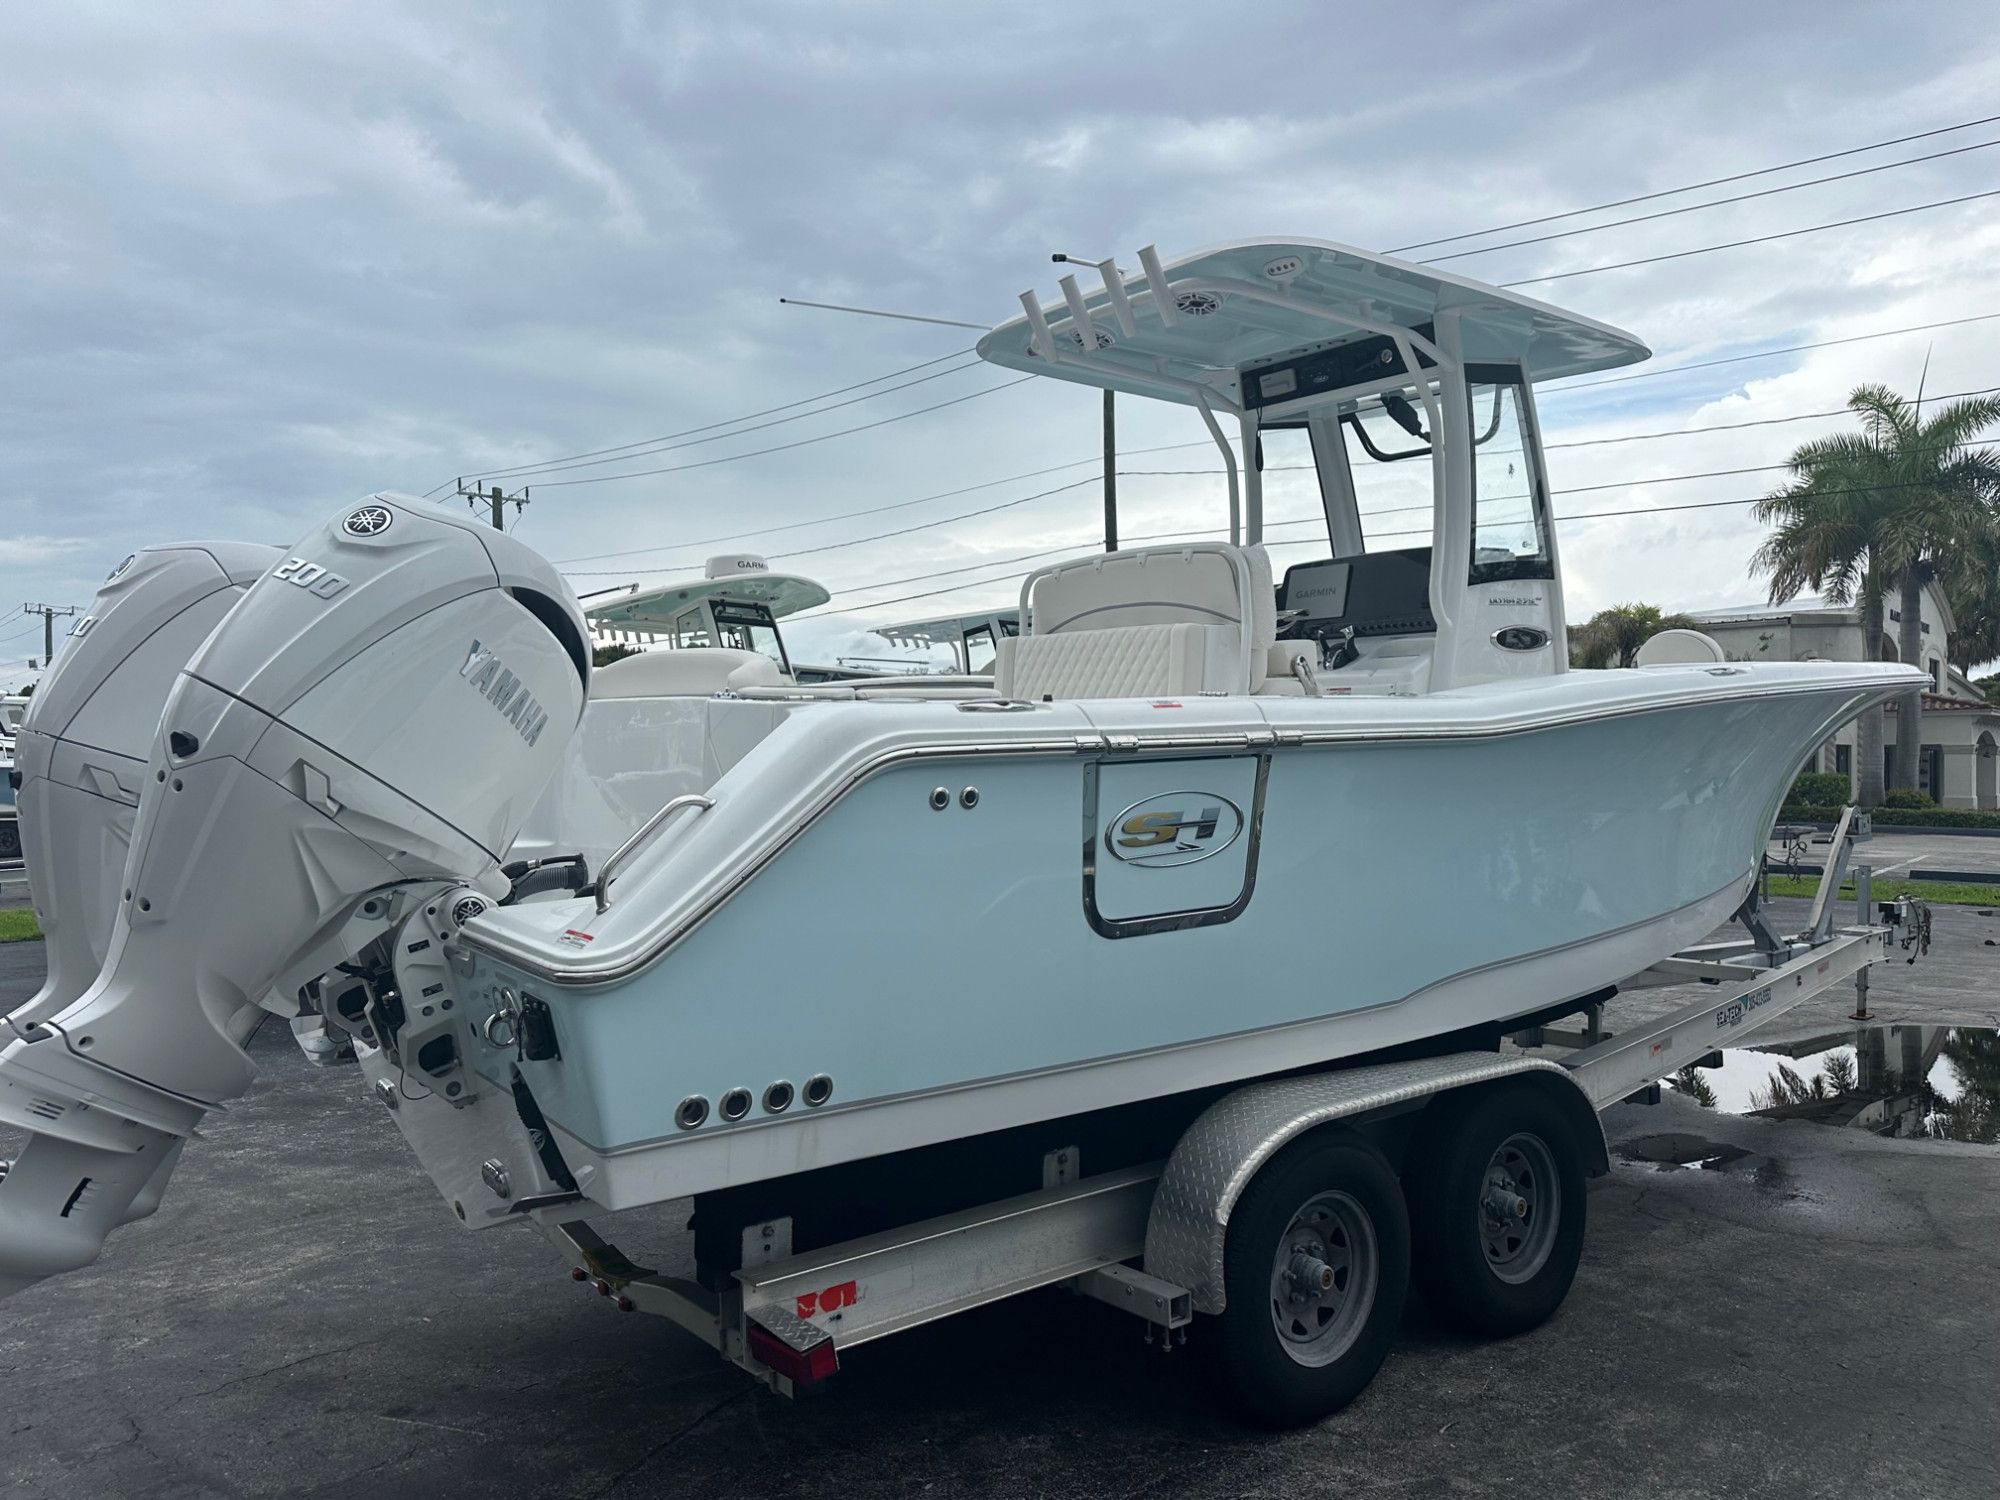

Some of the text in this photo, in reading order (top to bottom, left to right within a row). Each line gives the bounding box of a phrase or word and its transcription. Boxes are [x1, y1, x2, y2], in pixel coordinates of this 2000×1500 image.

[272, 557, 350, 600] 200
[1296, 586, 1336, 599] GARMIN
[459, 639, 549, 747] YAMAHA
